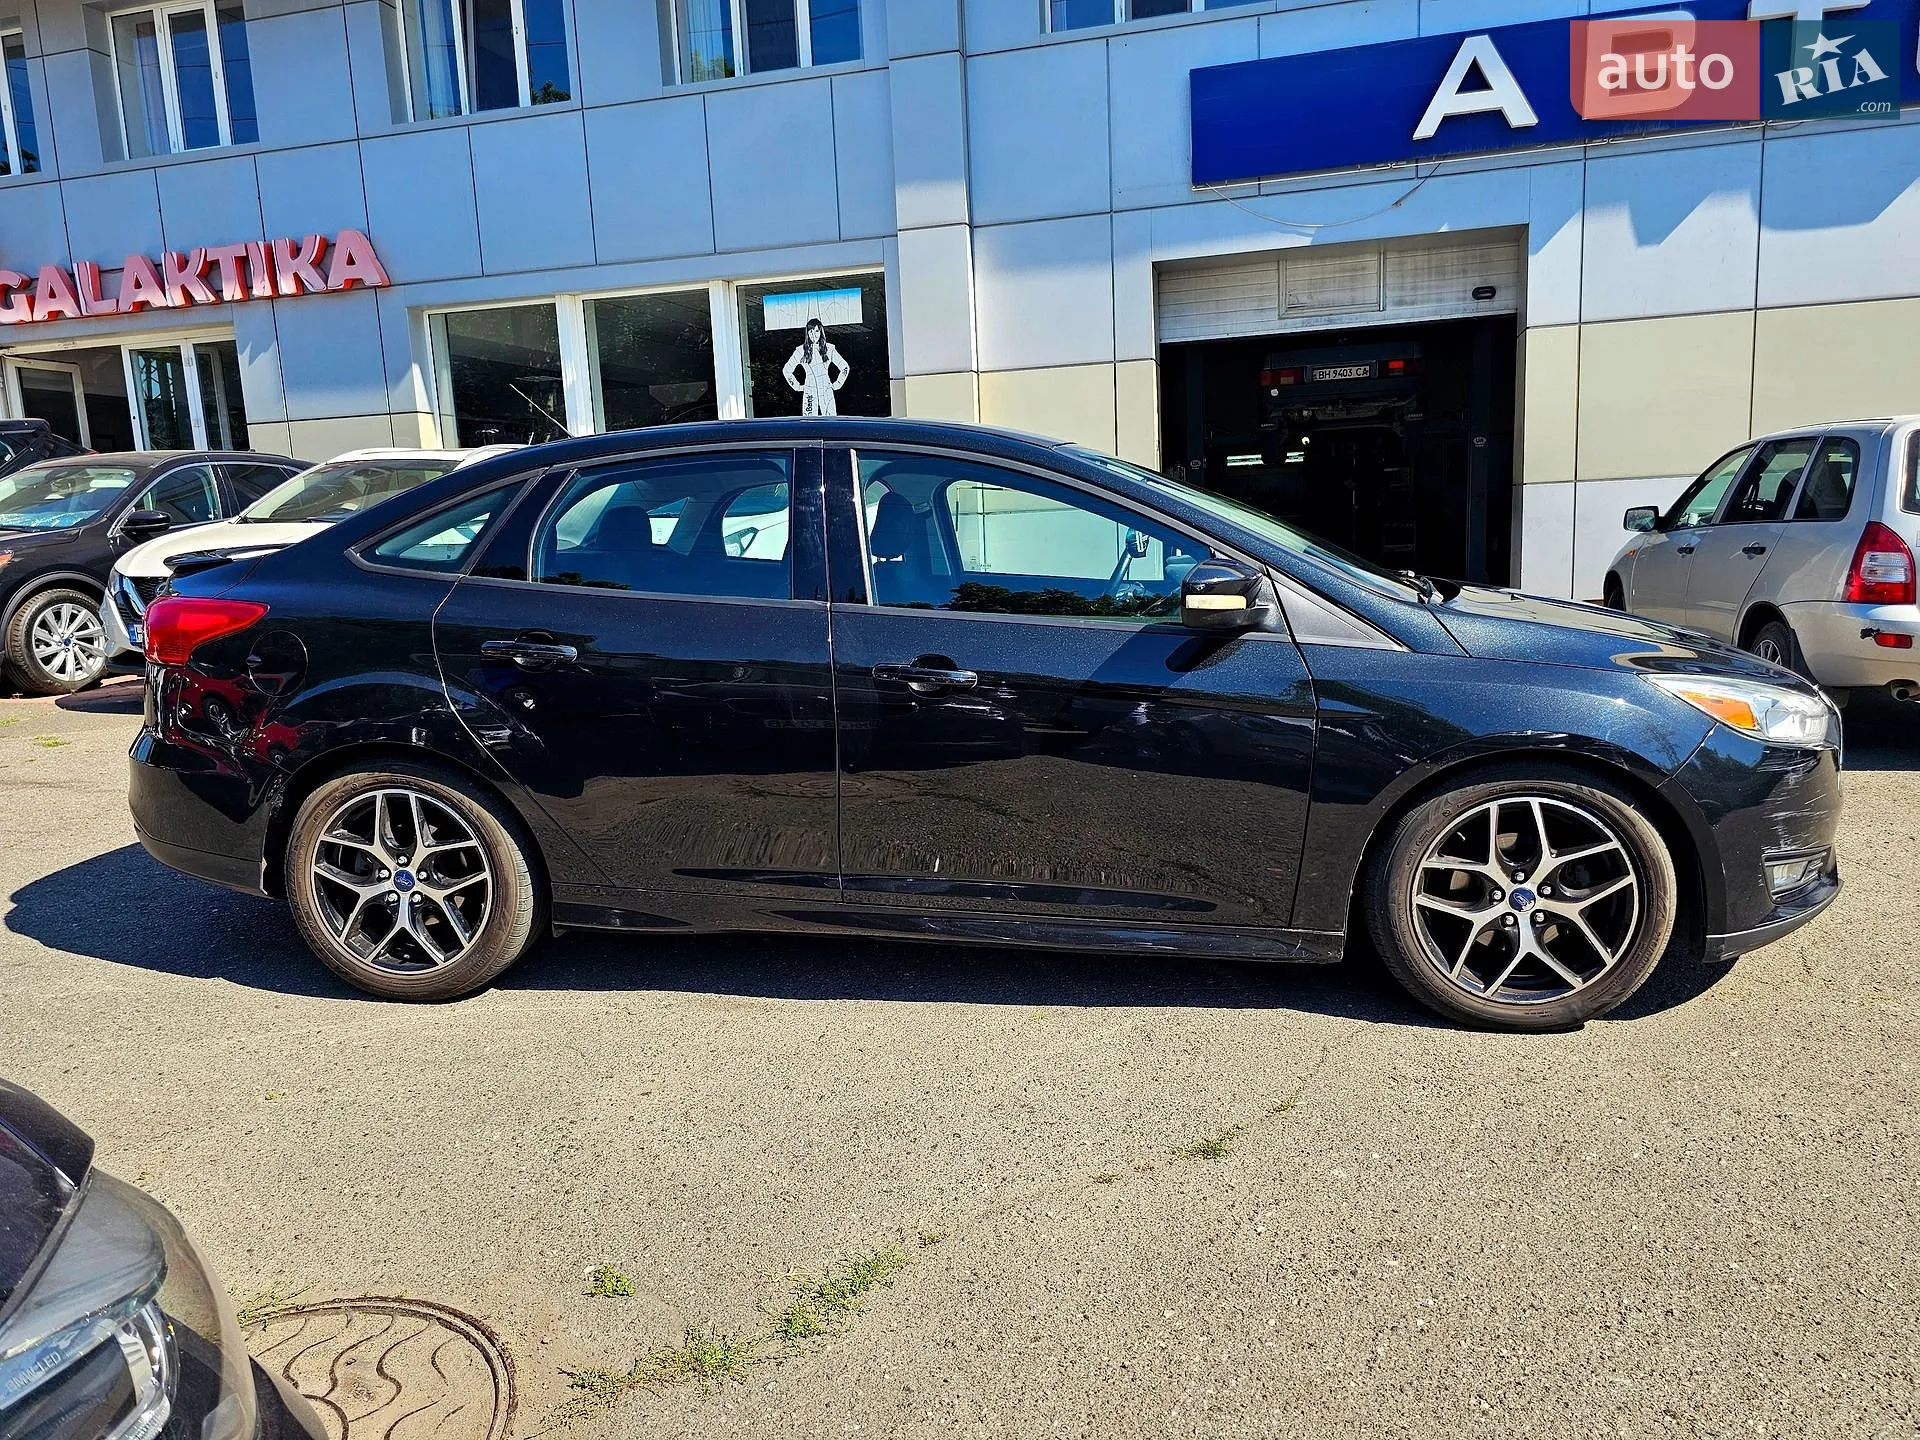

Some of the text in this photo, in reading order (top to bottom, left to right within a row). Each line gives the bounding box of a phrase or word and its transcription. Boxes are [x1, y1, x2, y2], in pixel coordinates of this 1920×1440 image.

[0, 229, 391, 325] GALAKTIKA
[1319, 370, 1330, 379] BH
[1333, 368, 1353, 379] 9403
